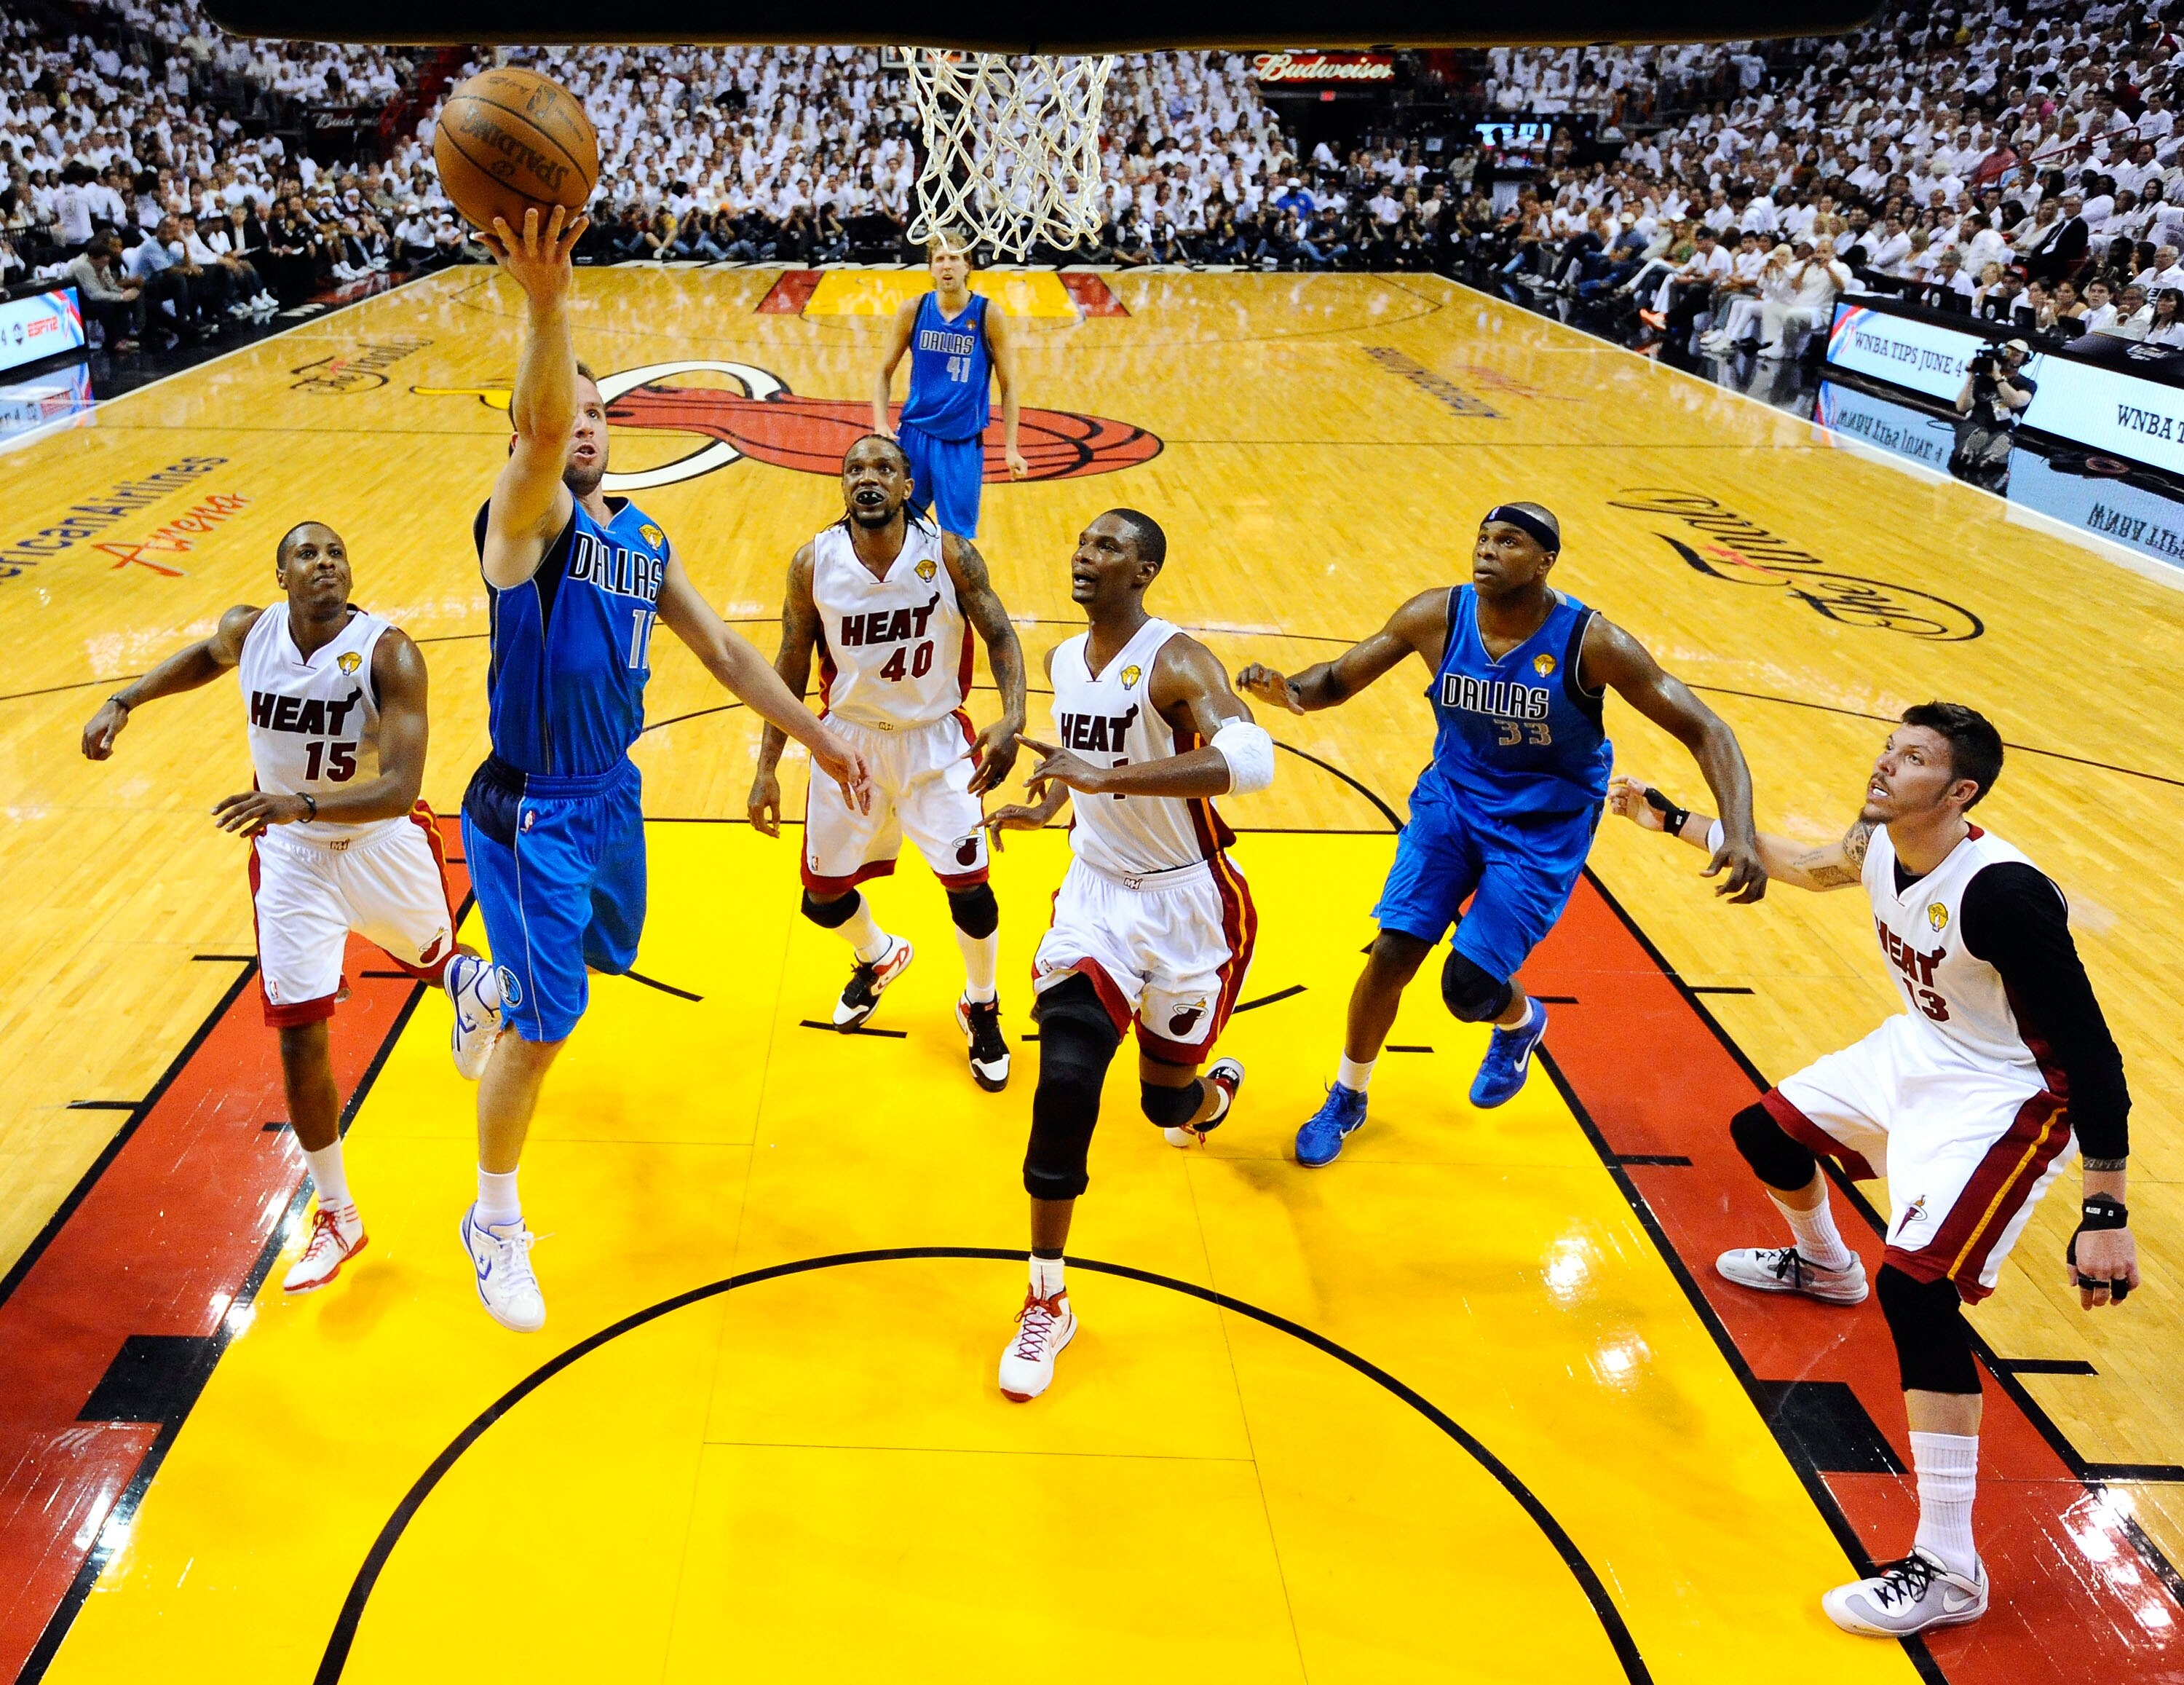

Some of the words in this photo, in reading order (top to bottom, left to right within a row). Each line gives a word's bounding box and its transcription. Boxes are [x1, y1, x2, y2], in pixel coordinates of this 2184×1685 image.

[1252, 54, 1396, 82] Budweiser
[459, 104, 570, 192] SPALDING
[919, 329, 976, 355] DALLAS
[1855, 331, 1888, 356] WNBA
[1891, 342, 1919, 364] TIPS
[1918, 350, 1953, 374] JUNE
[1955, 359, 1963, 378] 4
[946, 356, 972, 383] 41
[2118, 404, 2174, 441] WNBA
[90, 492, 251, 577] Arena
[567, 530, 664, 604] DALLAS
[841, 591, 941, 647] HEAT
[879, 639, 935, 683] 40
[250, 686, 363, 737] HEAT
[1441, 672, 1550, 720] DALLAS
[1061, 702, 1139, 753] HEAT
[1493, 718, 1552, 746] 33
[304, 741, 357, 783] 15
[1874, 912, 1947, 988] HEAT
[1902, 976, 1950, 1022] 13
